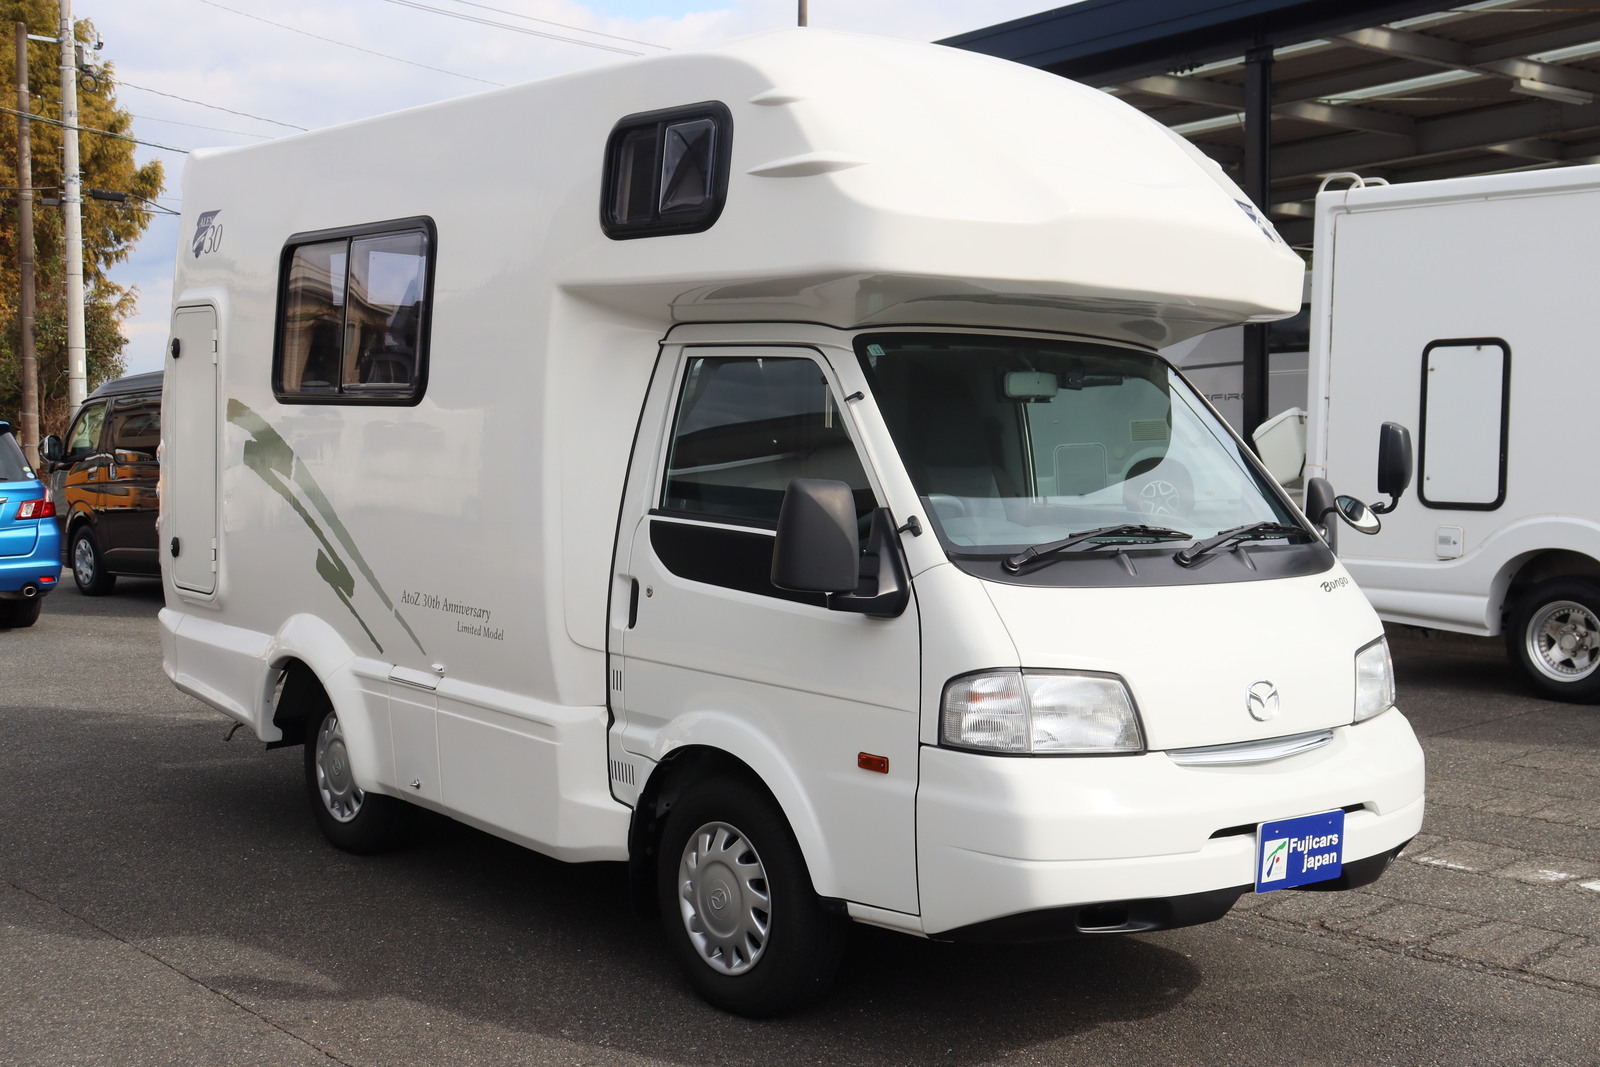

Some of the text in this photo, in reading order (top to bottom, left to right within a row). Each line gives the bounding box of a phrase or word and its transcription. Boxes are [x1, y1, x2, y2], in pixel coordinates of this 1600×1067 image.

[204, 223, 223, 254] 30
[1320, 577, 1348, 592] Bongo
[401, 590, 491, 624] AtoZ 30th Anniversary
[457, 621, 504, 641] Limited Model
[1289, 834, 1339, 854] Fujicars
[1302, 852, 1337, 873] japan
